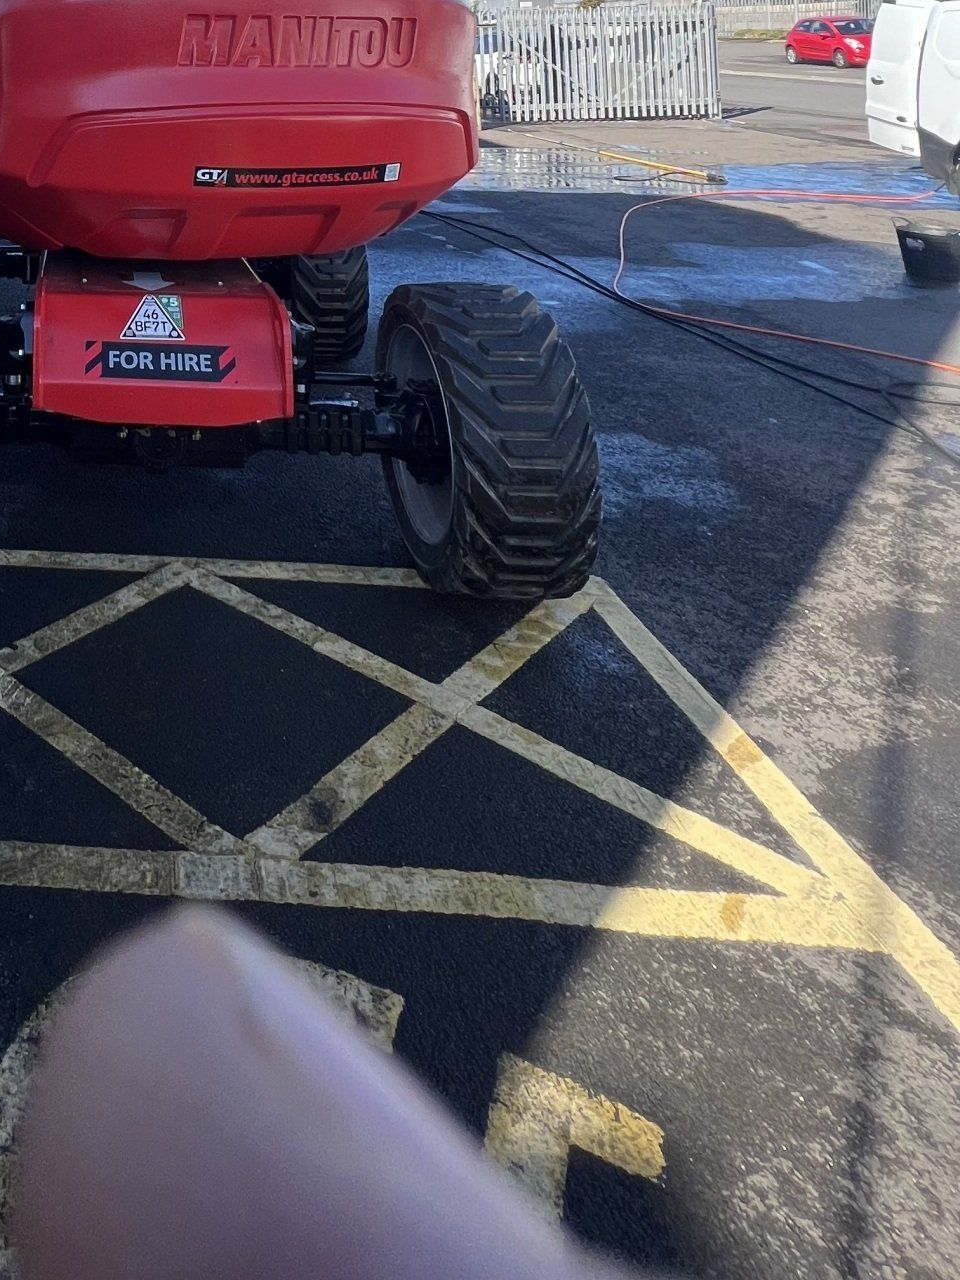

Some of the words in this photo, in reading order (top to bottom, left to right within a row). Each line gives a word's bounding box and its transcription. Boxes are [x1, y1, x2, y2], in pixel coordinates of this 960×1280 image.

[176, 13, 418, 68] MANITOU
[234, 167, 379, 187] www.gtaccess.co.uk
[143, 308, 159, 320] 46
[108, 350, 154, 370] FOR
[160, 352, 213, 372] HIRE
